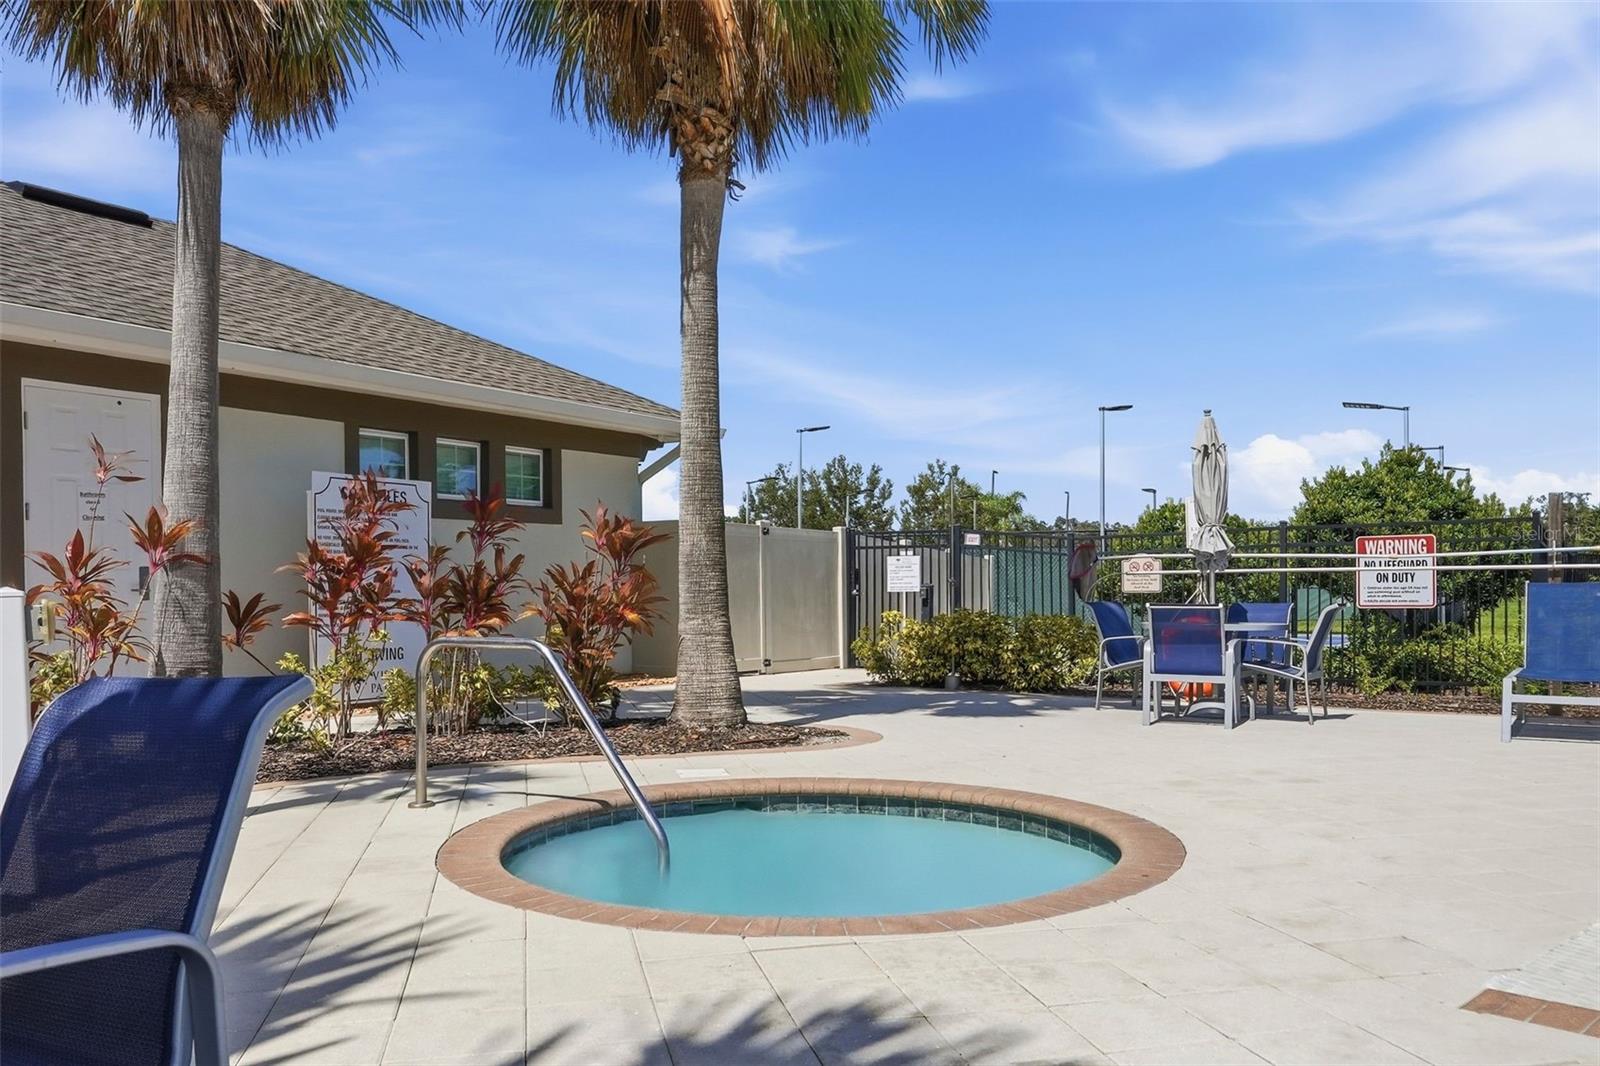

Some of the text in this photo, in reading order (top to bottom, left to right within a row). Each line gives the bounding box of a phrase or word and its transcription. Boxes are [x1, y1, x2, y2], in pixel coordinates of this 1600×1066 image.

[1365, 539, 1427, 554] WARNING
[1376, 572, 1416, 583] ON DUTY
